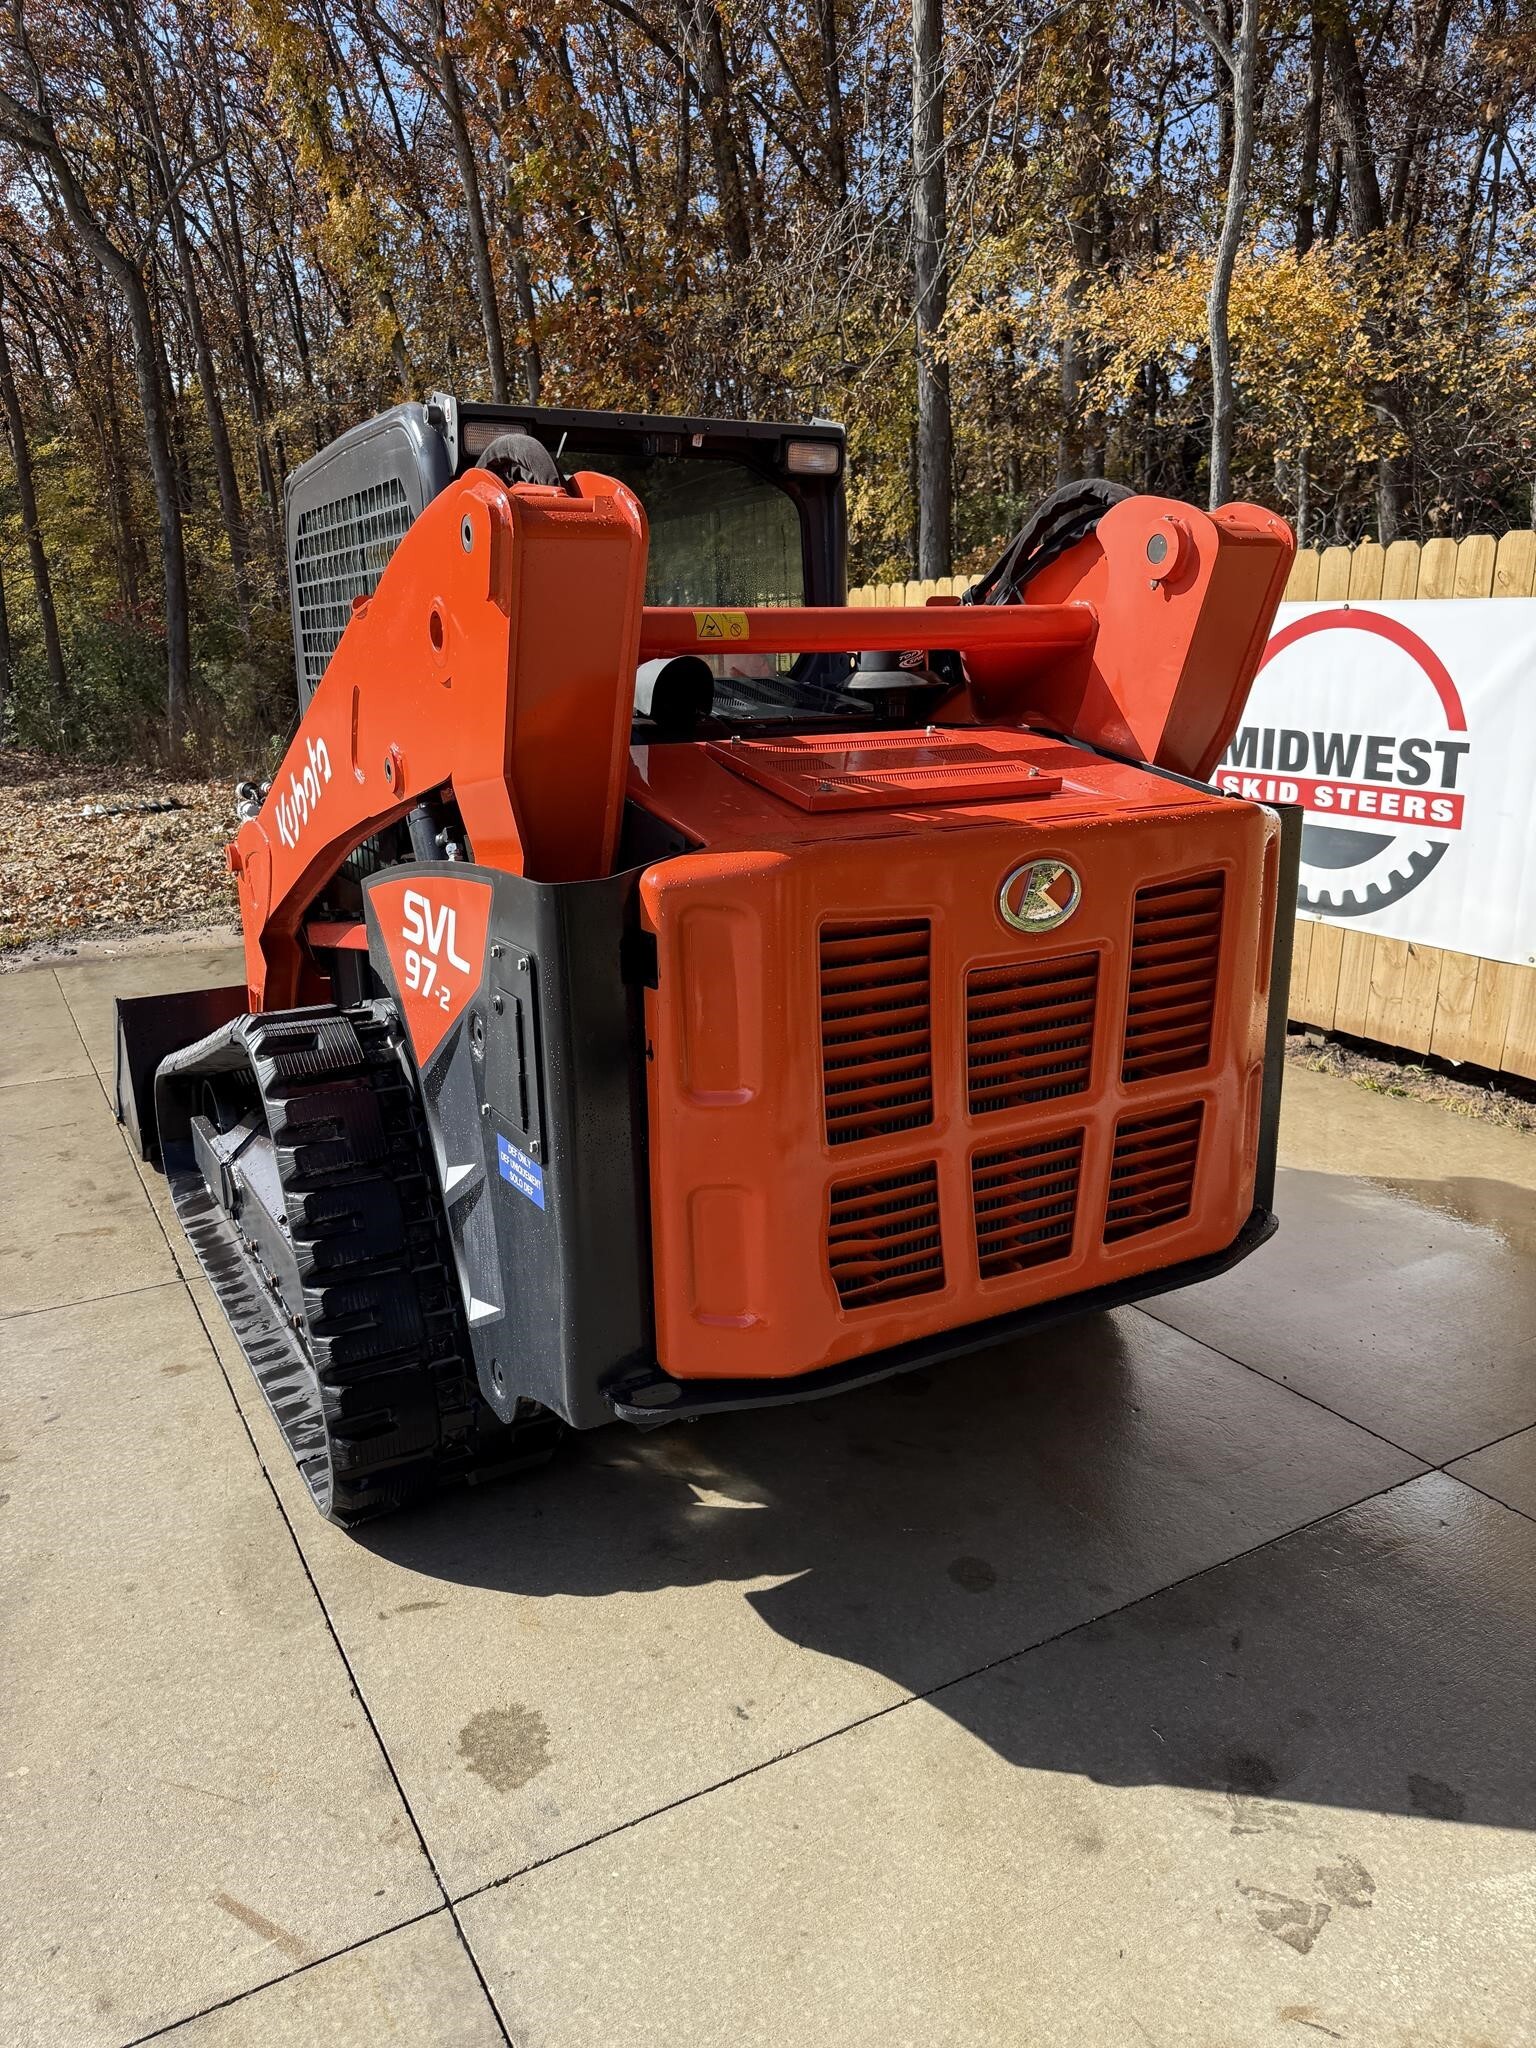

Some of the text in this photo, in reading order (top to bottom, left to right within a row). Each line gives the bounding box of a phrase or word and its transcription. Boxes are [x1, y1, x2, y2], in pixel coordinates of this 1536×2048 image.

[1220, 727, 1470, 789] MIDWEST
[275, 736, 332, 849] Kubota
[1222, 776, 1454, 823] SKID STEERS
[402, 889, 470, 975] SVL
[501, 1151, 509, 1165] DEF
[508, 1144, 531, 1169] DEF ONLY
[509, 1170, 534, 1196] SOLO DEF
